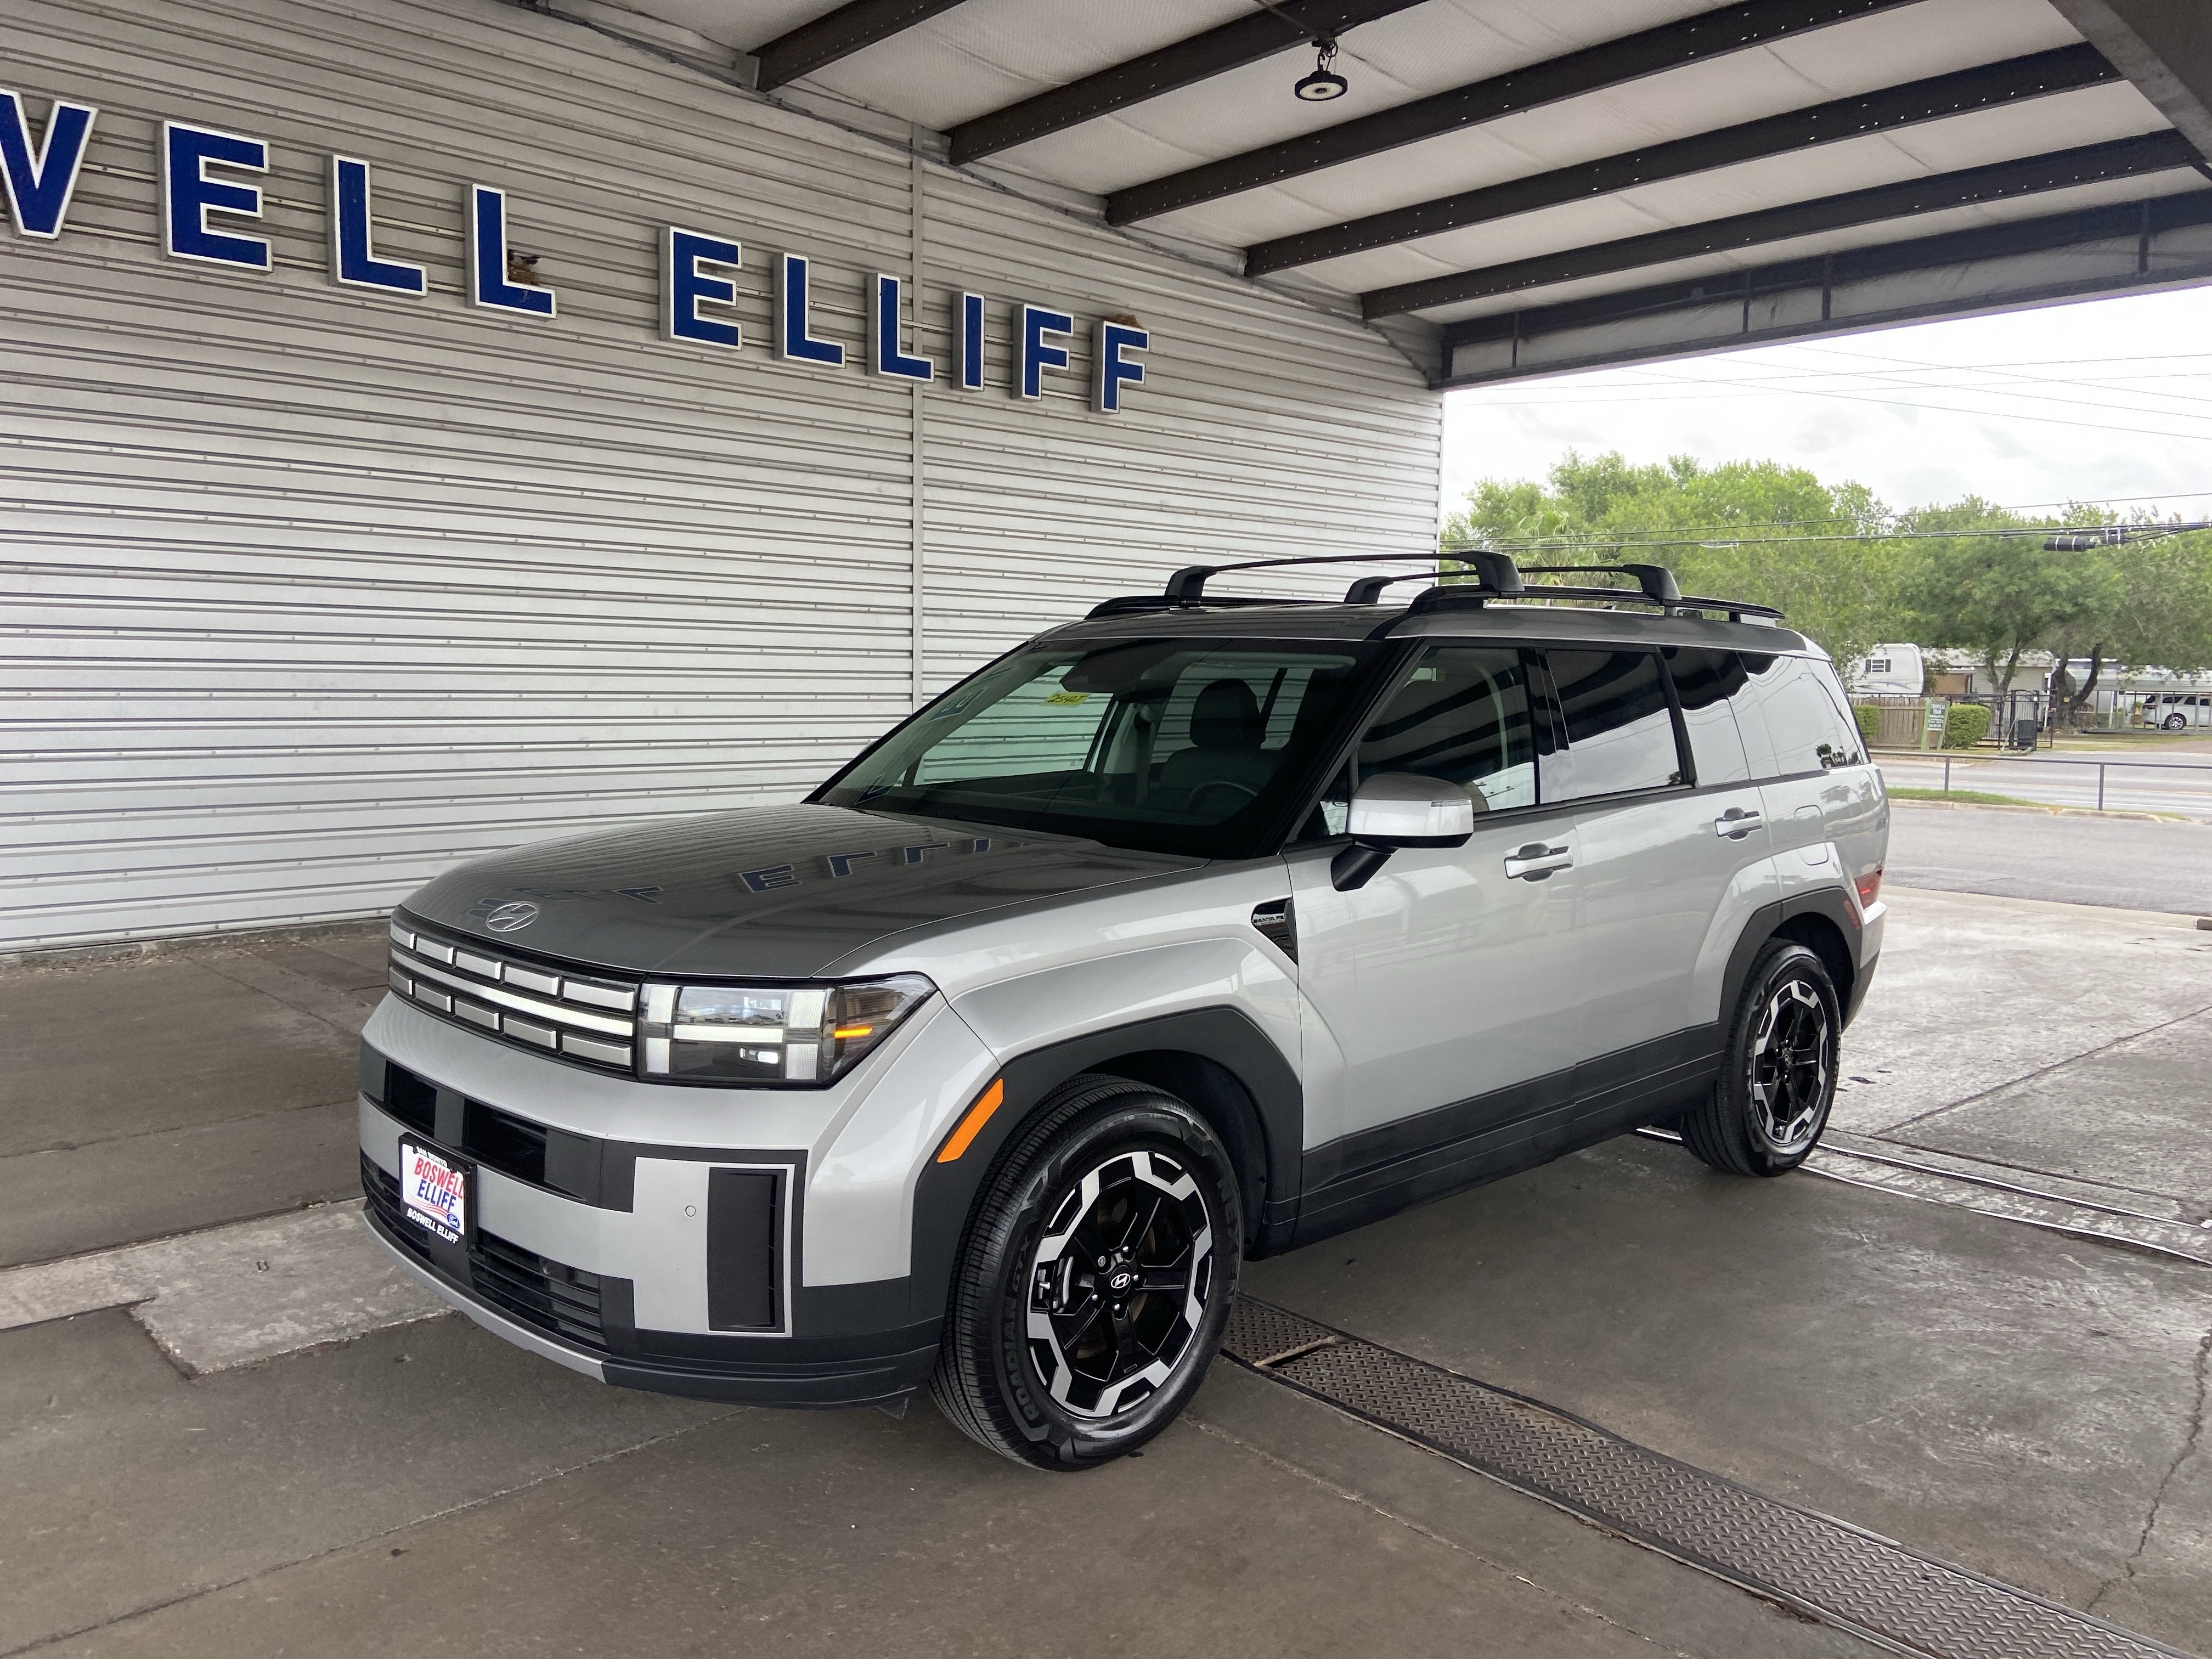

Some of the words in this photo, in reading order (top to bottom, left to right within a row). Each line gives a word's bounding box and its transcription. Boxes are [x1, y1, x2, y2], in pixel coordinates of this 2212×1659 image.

[663, 225, 1150, 414] ELLIFF
[414, 1157, 464, 1199] BOSWELL
[417, 1178, 457, 1212] ELLIFF
[407, 1207, 437, 1232] BOSWELL
[436, 1224, 459, 1244] ELLIFF
[1216, 1177, 1241, 1305] NEXEN
[1003, 1297, 1041, 1422] ROADIAN
